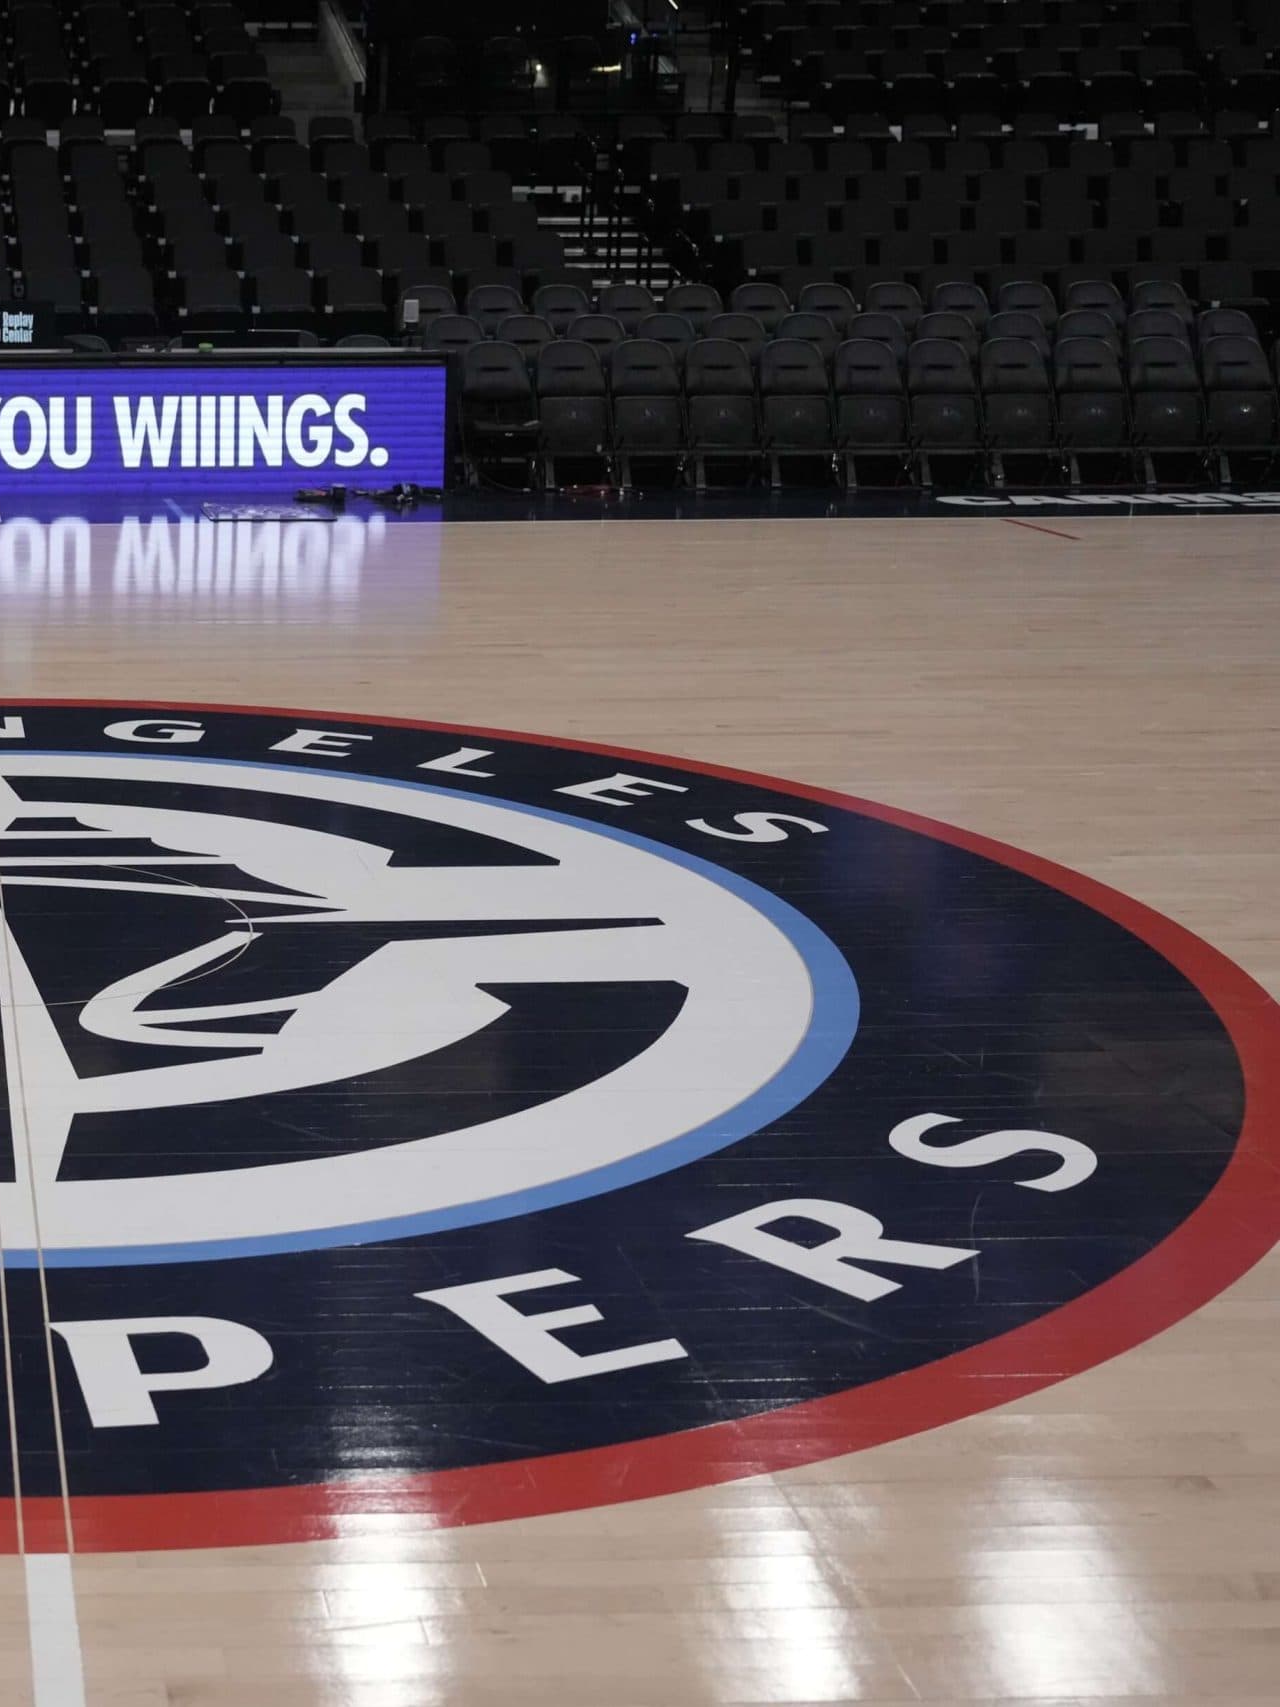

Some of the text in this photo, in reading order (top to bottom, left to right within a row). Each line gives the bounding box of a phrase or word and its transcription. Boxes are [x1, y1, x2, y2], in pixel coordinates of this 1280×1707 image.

[2, 311, 34, 329] Replay
[2, 327, 33, 343] Center
[113, 394, 389, 468] WIIINGS.
